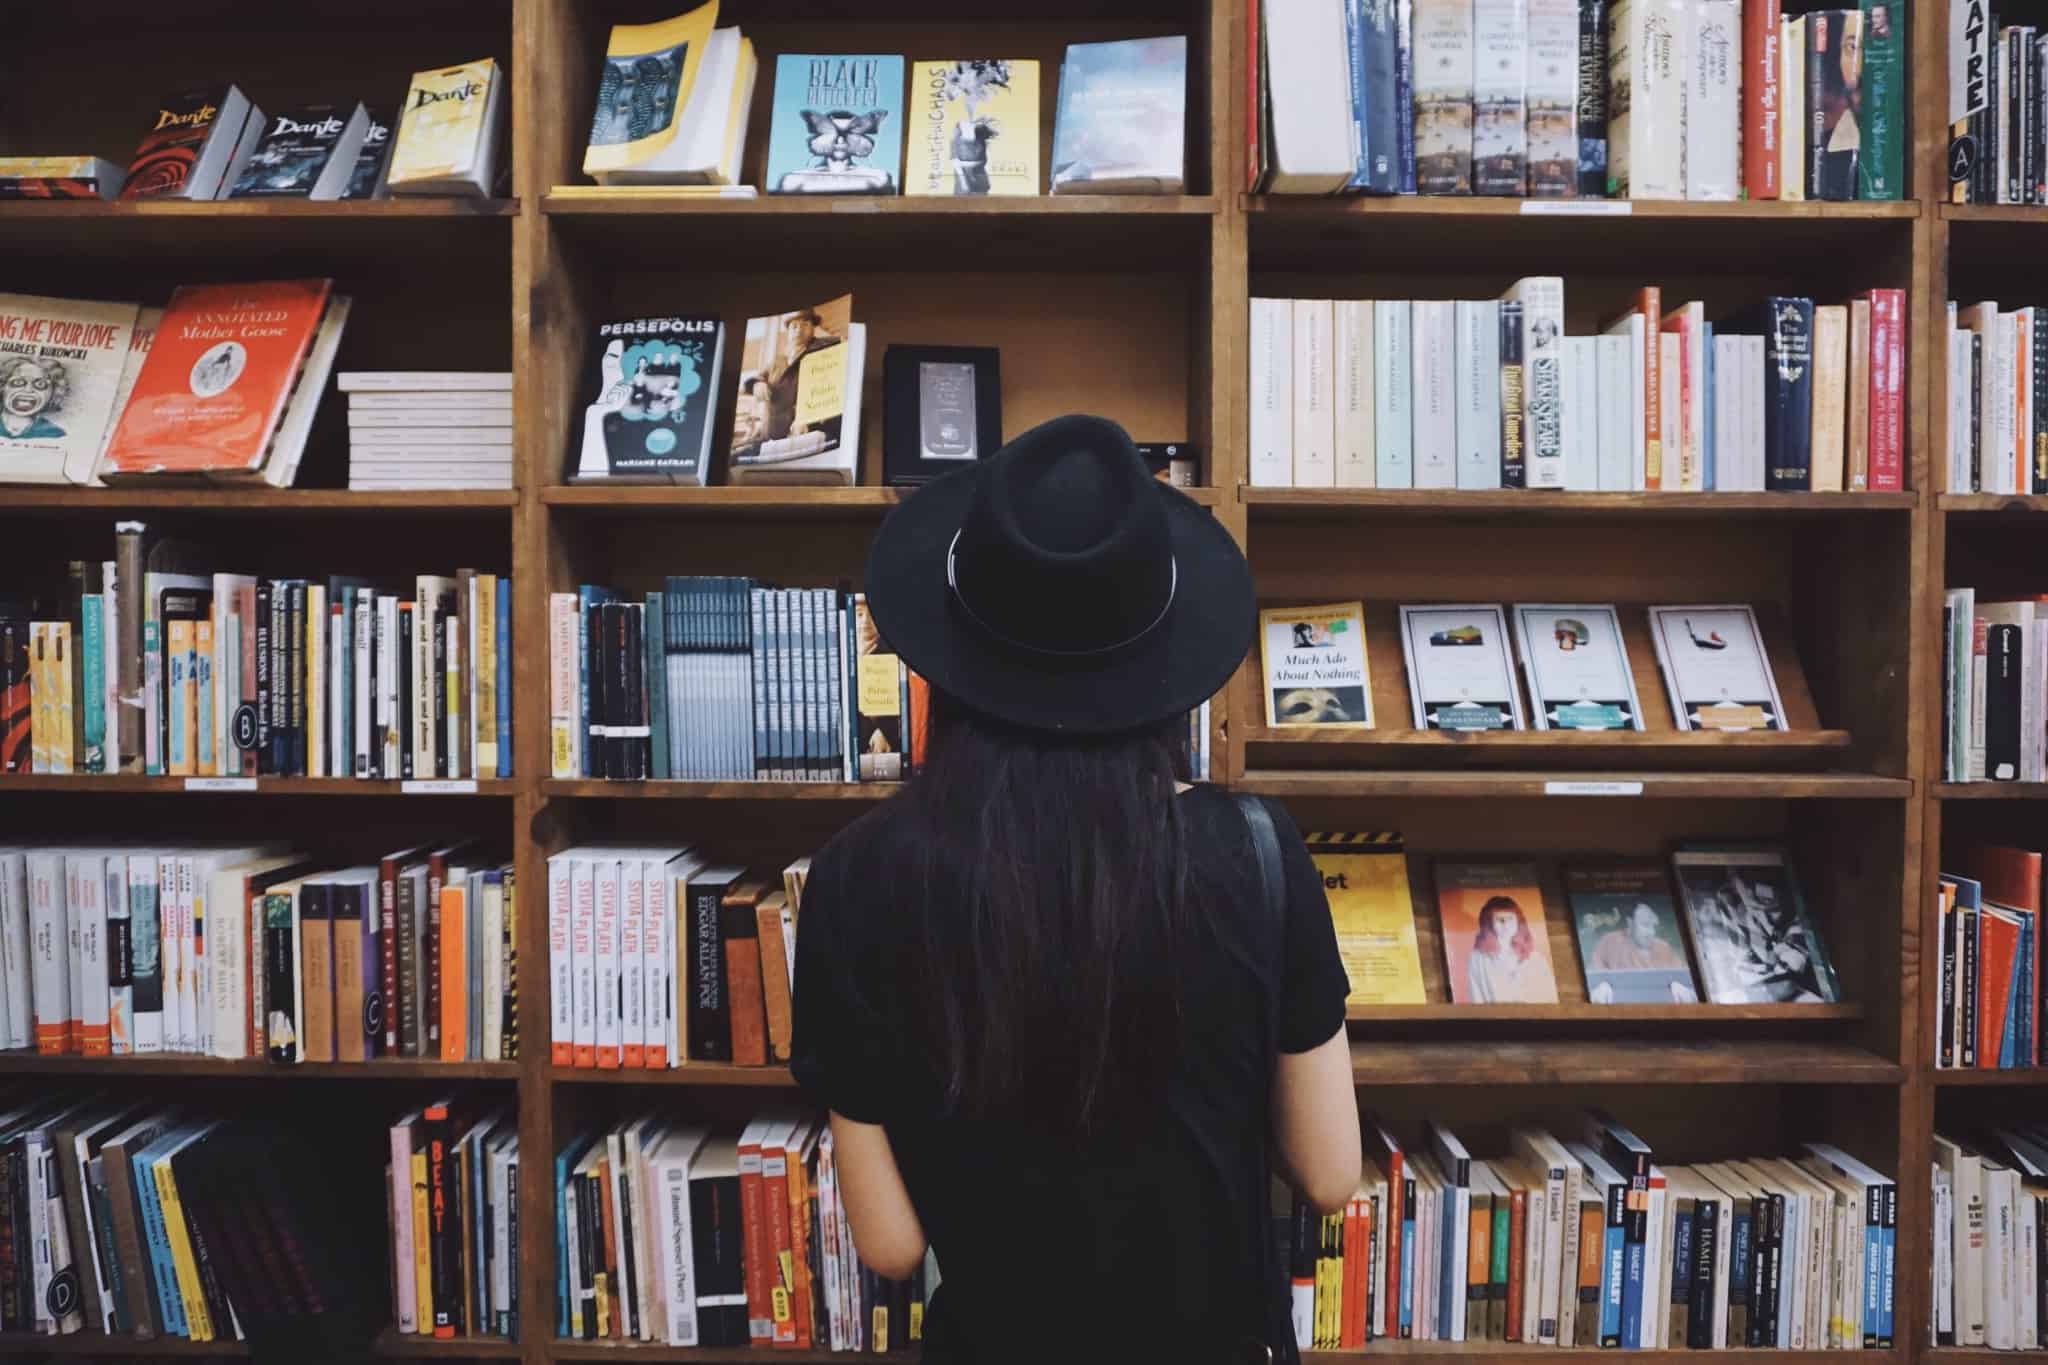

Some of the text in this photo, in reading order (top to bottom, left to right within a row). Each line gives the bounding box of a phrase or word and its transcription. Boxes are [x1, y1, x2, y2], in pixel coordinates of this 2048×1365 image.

[809, 58, 878, 89] BLACK
[1965, 0, 1984, 112] ATRE
[411, 77, 484, 110] Dante
[1580, 55, 1593, 123] EVIDENCE
[153, 103, 217, 130] Dante
[270, 114, 345, 138] Dante
[1954, 147, 1969, 172] A
[19, 317, 43, 342] ME
[46, 320, 85, 346] YOUR
[84, 324, 121, 351] LOVE
[180, 325, 287, 339] Mother Goose
[193, 311, 288, 324] ANNOTATED
[600, 320, 715, 336] PERSEPOLIS
[39, 345, 88, 361] BUKOWSKI
[1506, 365, 1522, 461] Five Great Comedies
[1530, 359, 1553, 457] SHAKESPEARE
[616, 459, 656, 467] MARJANE
[357, 610, 368, 651] Beowulf
[559, 620, 569, 667] AMERICAN
[1273, 668, 1361, 682] About Nothing
[1284, 652, 1347, 666] Much Ado
[258, 627, 268, 748] ILLUSIONS Richard Bach
[241, 714, 250, 740] B
[401, 880, 409, 904] THE
[551, 878, 570, 951] SYLVIA PLATH
[574, 880, 593, 953] SYLVIA PLATH
[597, 880, 616, 955] SYLVIA PLATH
[623, 880, 642, 953] SYLVIA PLATH
[645, 880, 664, 954] SYLVIA PLATH
[216, 917, 226, 1010] ROBERT BURNS
[698, 895, 710, 1008] EDGAR ALLAN POE
[1944, 952, 1954, 970] The
[368, 998, 380, 1025] C
[432, 1139, 444, 1232] BEAT
[1550, 1186, 1560, 1222] Hamlet
[671, 1186, 687, 1304] Edmund Spenser's Poetry
[1566, 1204, 1577, 1257] HAMLET
[1630, 1246, 1640, 1282] HAMLET
[1699, 1227, 1713, 1282] HAMLET
[1611, 1249, 1622, 1305] HAMLET
[56, 1283, 69, 1308] D
